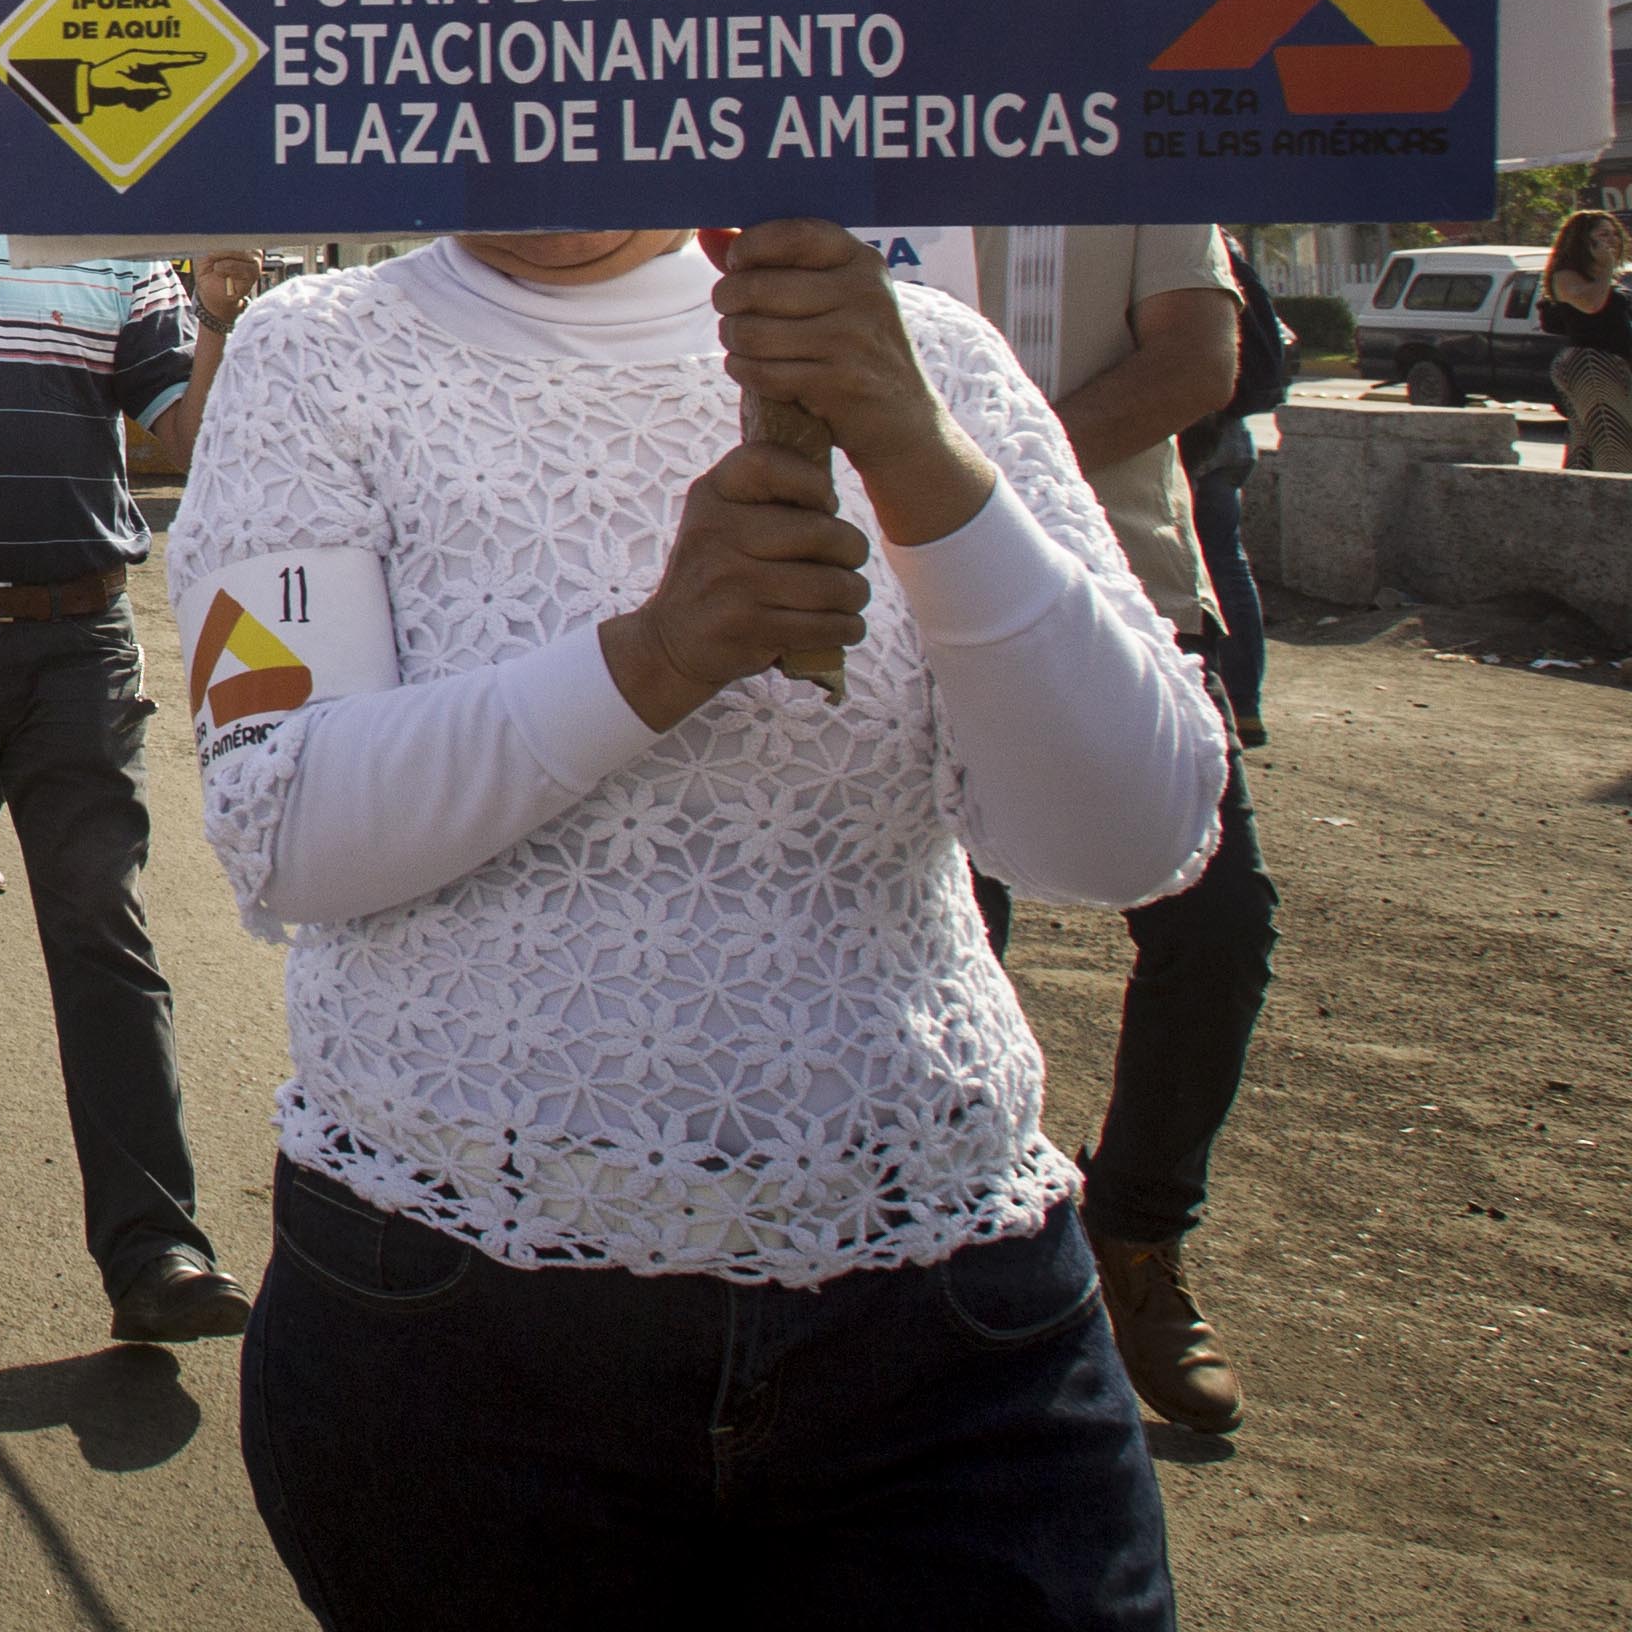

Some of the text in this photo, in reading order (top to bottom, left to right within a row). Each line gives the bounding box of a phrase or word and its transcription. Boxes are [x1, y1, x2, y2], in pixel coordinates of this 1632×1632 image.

[63, 16, 180, 39] DE AQUÍ!
[275, 14, 903, 85] ESTACIONAMIENTO
[1143, 88, 1258, 115] PLAZA
[275, 92, 1118, 164] PLAZA DE LAS AMERICAS
[1143, 131, 1185, 158] DE
[1198, 130, 1263, 157] LAS
[279, 566, 310, 623] 11
